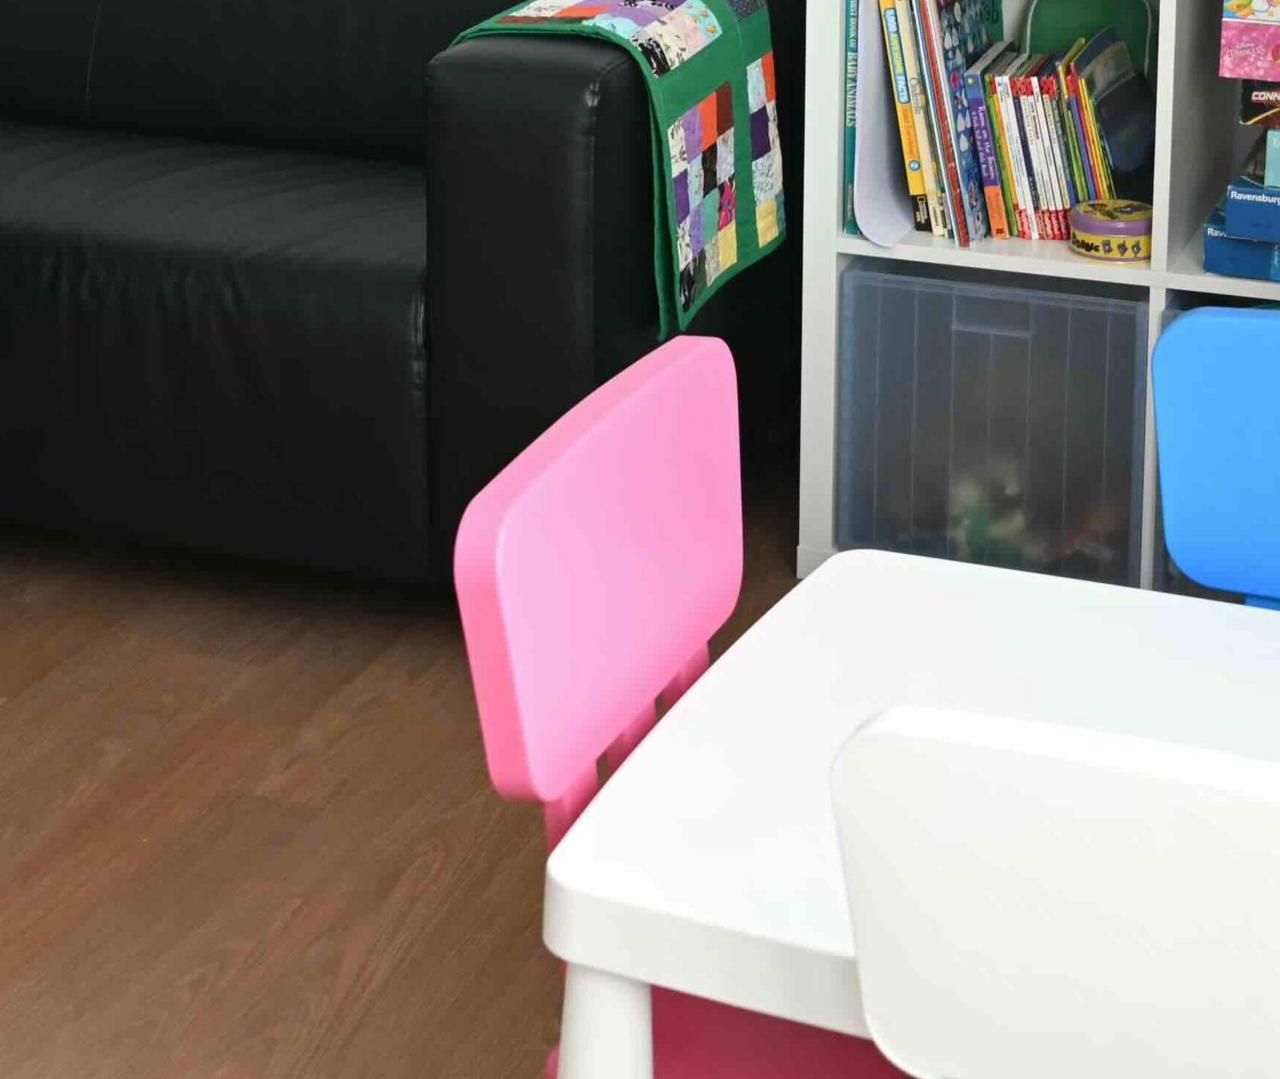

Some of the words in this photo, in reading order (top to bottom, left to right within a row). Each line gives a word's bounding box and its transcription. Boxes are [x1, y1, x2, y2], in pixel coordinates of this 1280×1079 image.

[847, 52, 858, 77] BABY
[896, 73, 909, 104] FACTS
[847, 79, 857, 127] ANIMALS
[977, 105, 987, 126] Room
[981, 129, 987, 139] on
[987, 155, 996, 179] Broom
